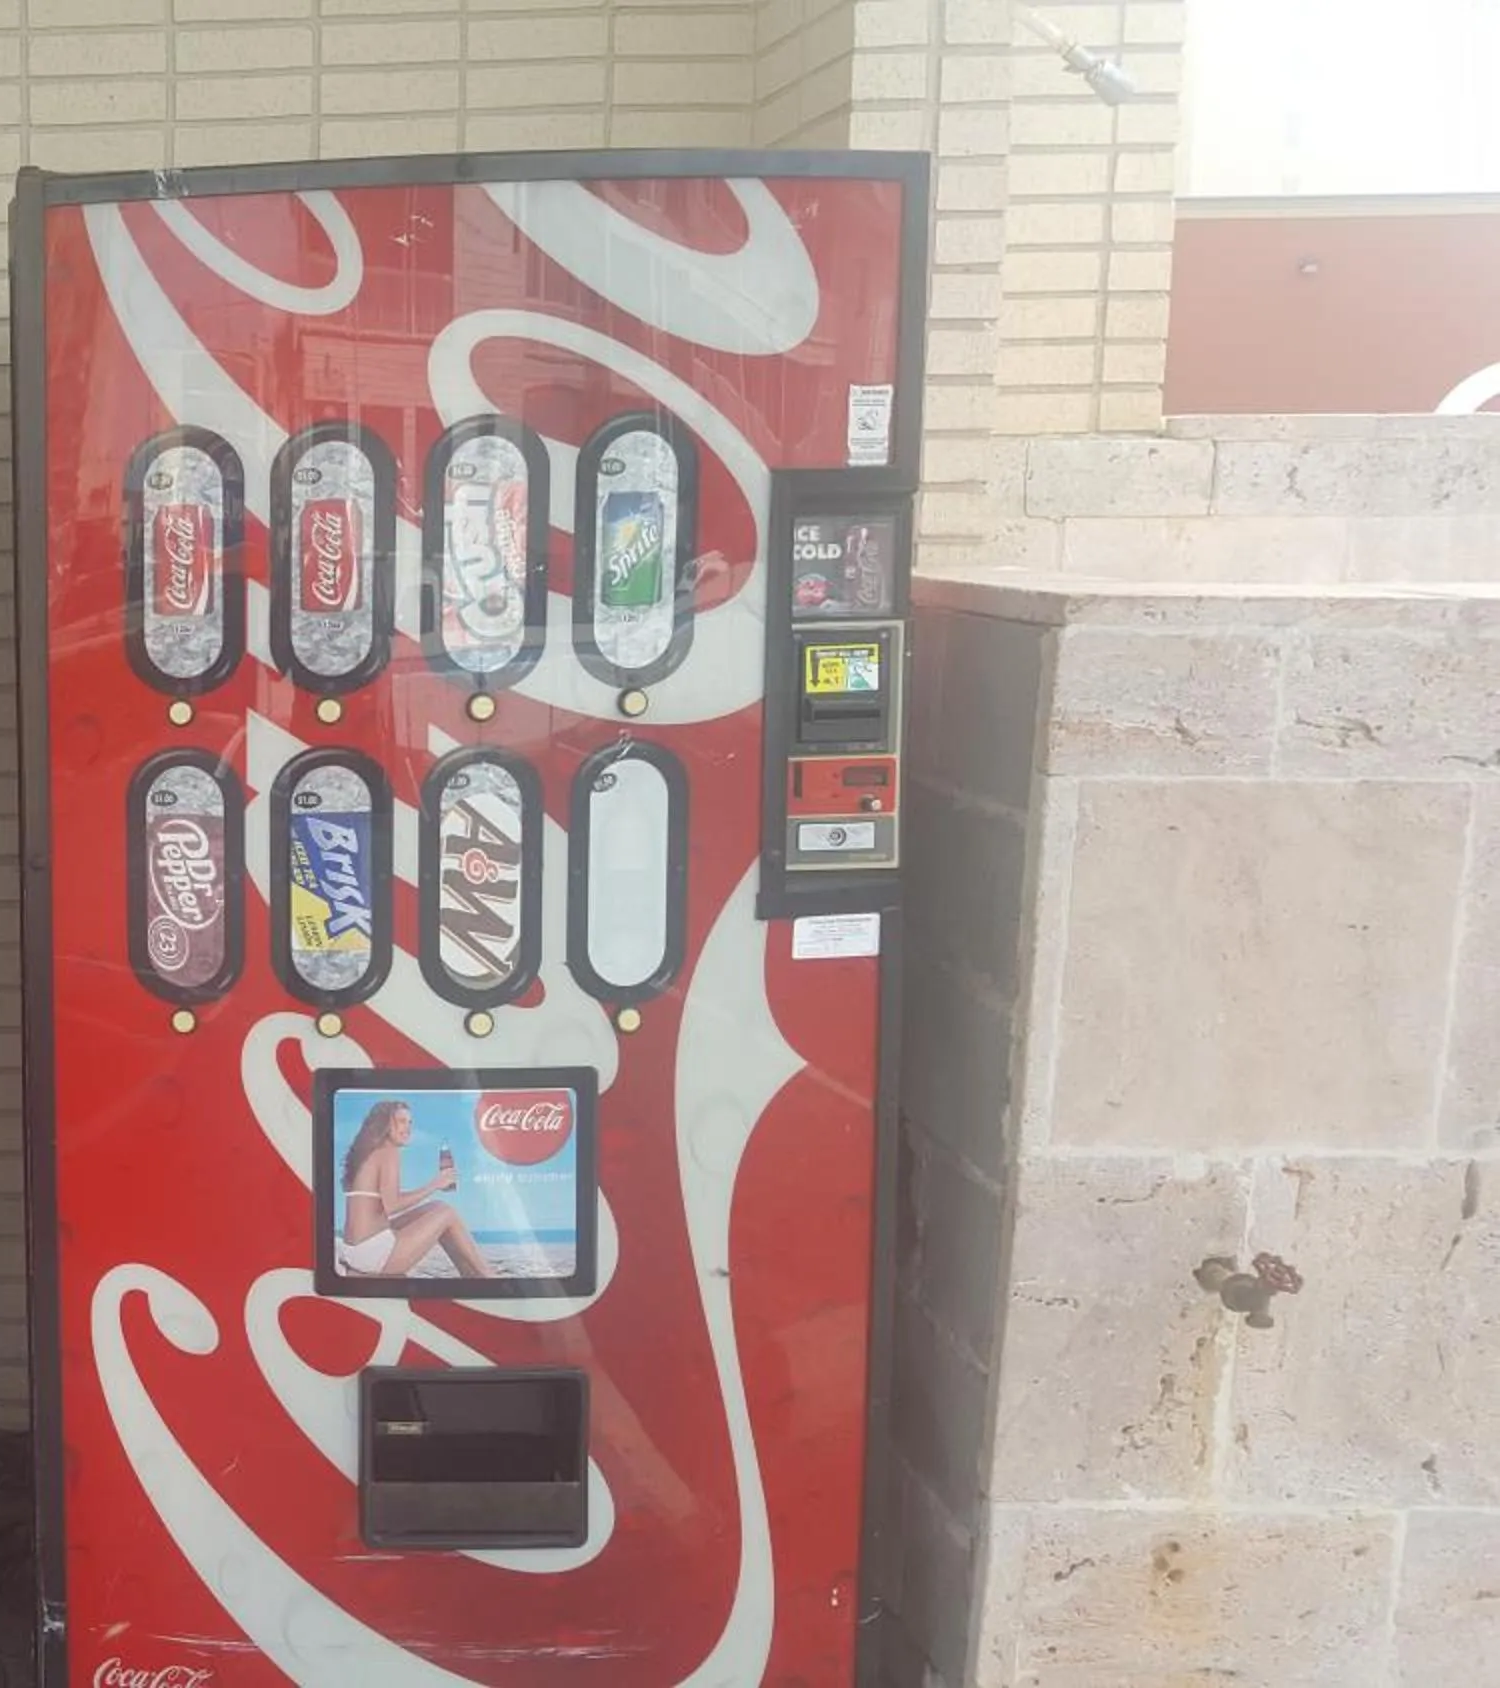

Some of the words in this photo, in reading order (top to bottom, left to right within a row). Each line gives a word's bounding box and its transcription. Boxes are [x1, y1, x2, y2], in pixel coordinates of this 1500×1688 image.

[793, 525, 820, 542] ICE
[608, 519, 661, 586] Sprite
[793, 543, 842, 561] COLD
[157, 821, 209, 923] Pepper
[186, 858, 217, 897] Dr
[158, 931, 178, 953] 23
